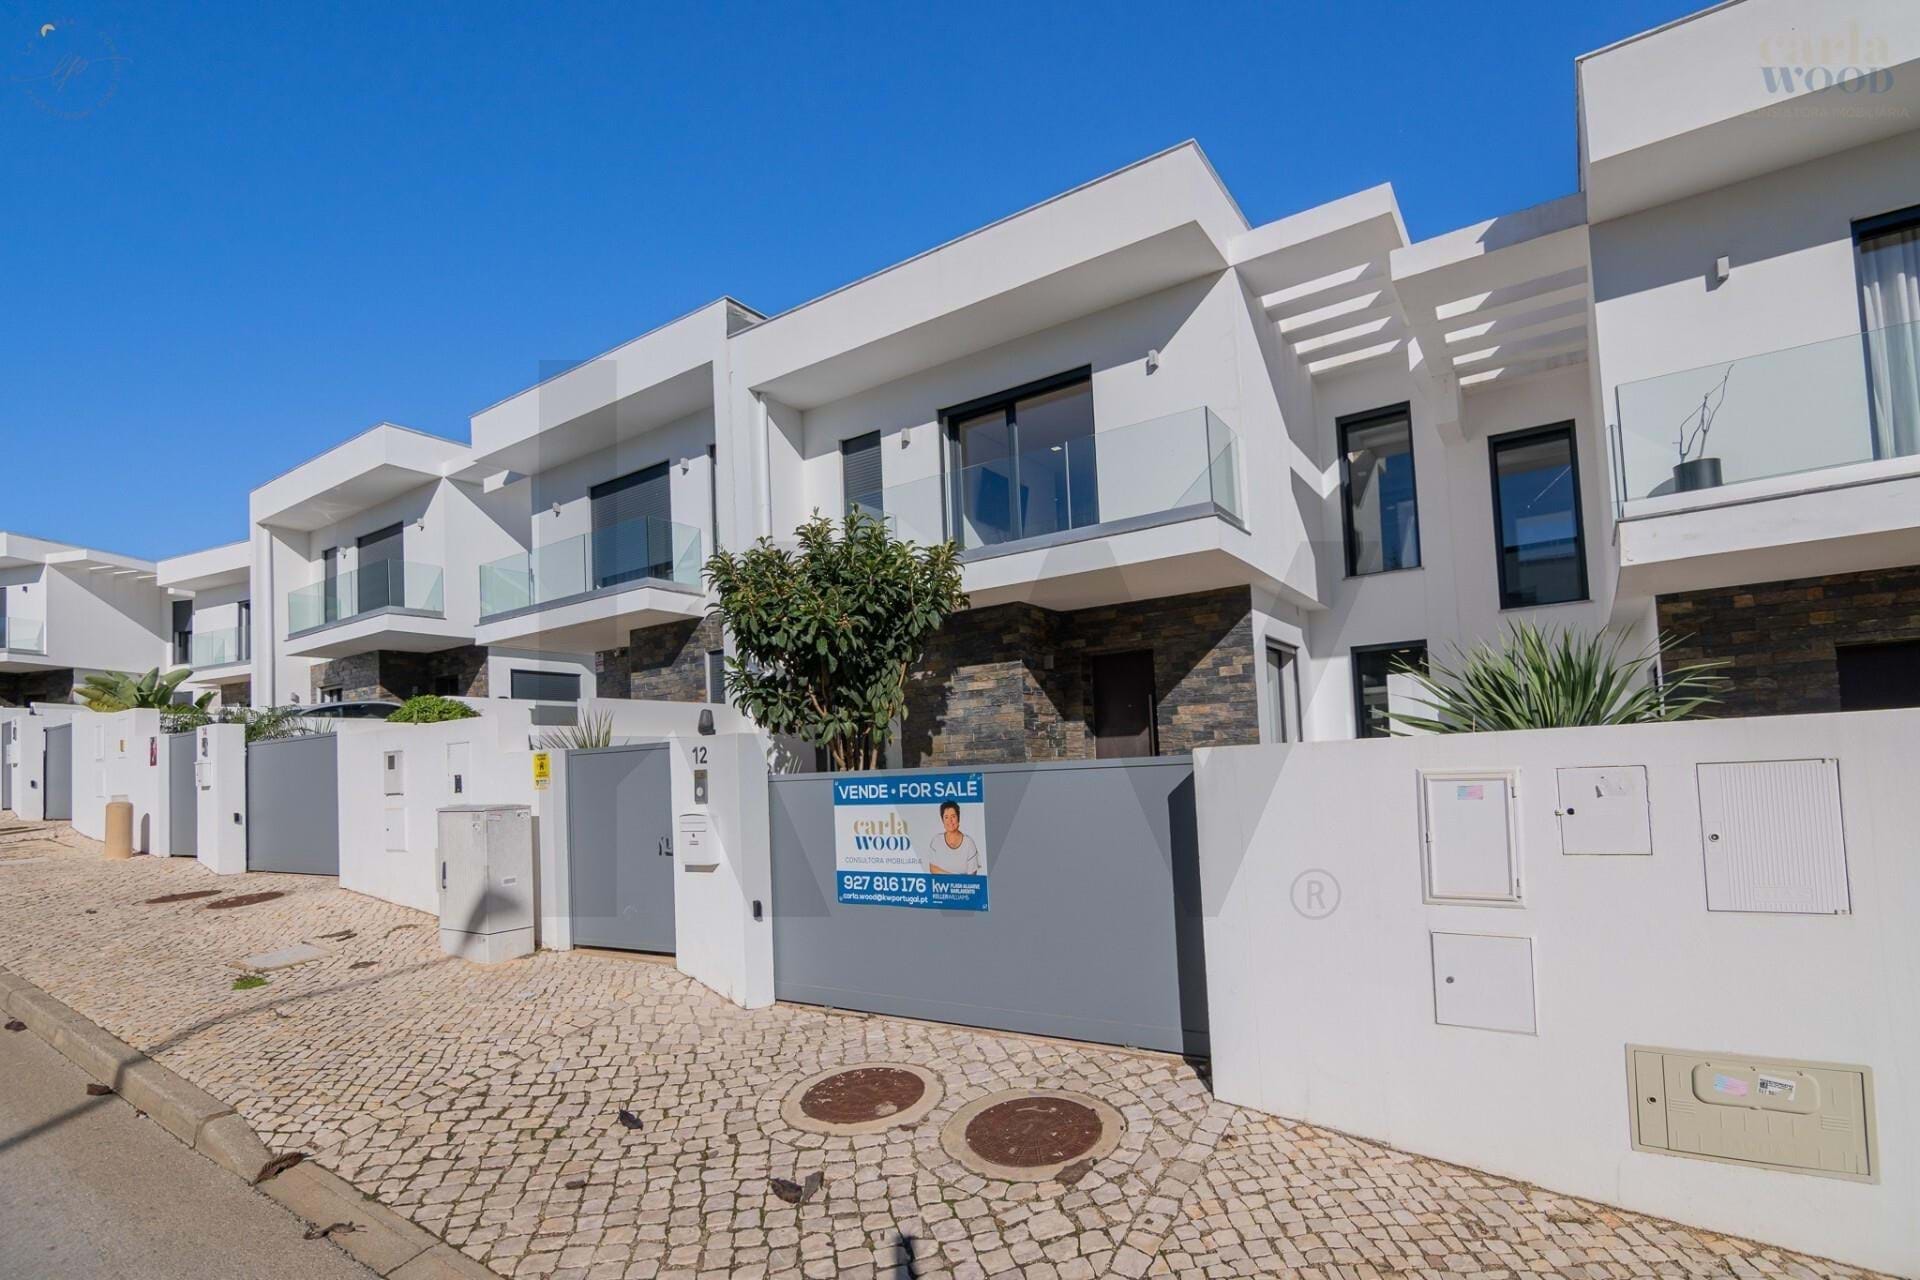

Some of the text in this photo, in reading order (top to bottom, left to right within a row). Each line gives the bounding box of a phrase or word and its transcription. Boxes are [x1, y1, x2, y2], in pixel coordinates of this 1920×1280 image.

[692, 746, 708, 765] 12
[838, 780, 977, 799] VENDE FOR SALE
[853, 812, 908, 834] carla
[855, 835, 911, 850] WOOD
[843, 875, 927, 893] 927 816 176
[932, 878, 950, 893] kw
[843, 892, 928, 904] carla.wood@kwportugal.pt
